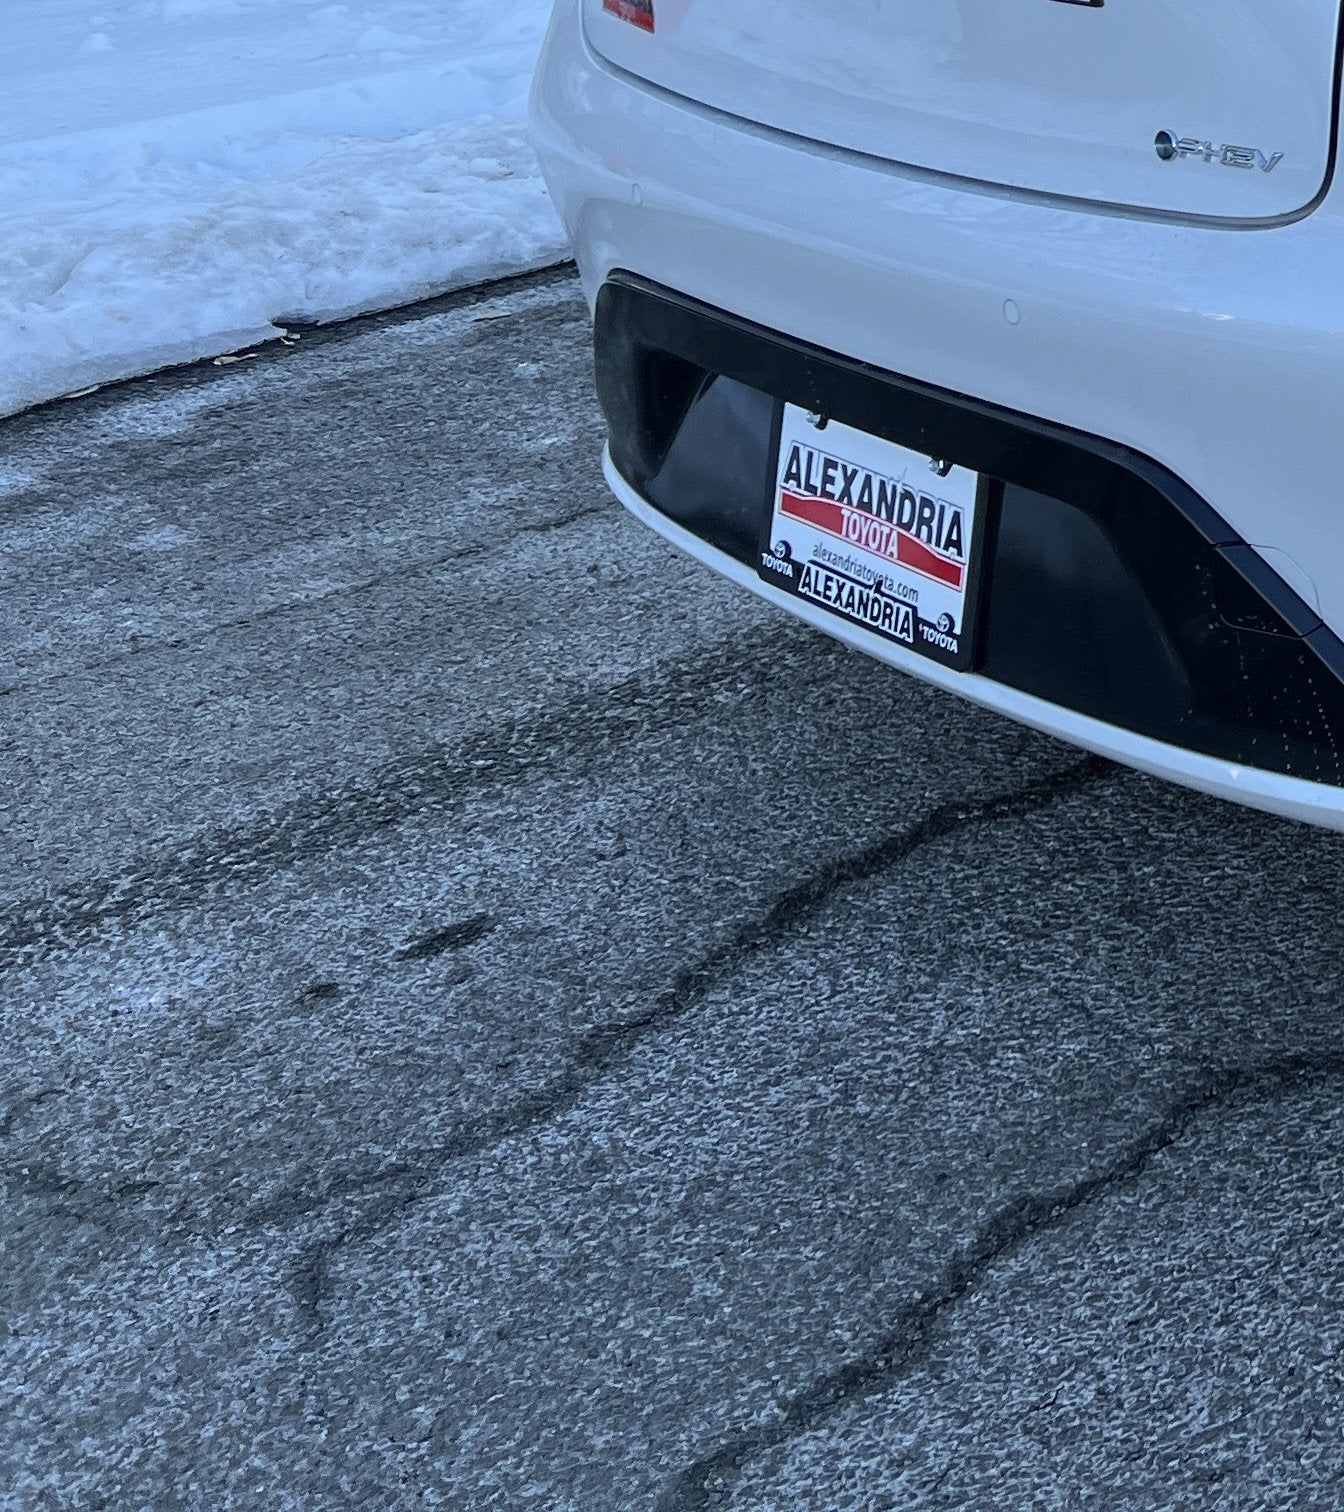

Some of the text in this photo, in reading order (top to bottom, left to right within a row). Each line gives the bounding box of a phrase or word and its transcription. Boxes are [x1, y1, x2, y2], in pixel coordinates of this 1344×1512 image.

[1179, 137, 1285, 173] PHEV
[783, 445, 964, 559] ALEXANDRIA
[840, 508, 899, 559] TOYOTA
[761, 553, 793, 578] TOYOTA
[799, 563, 913, 642] ALEXANDRIA
[921, 625, 958, 654] TOYOTA
